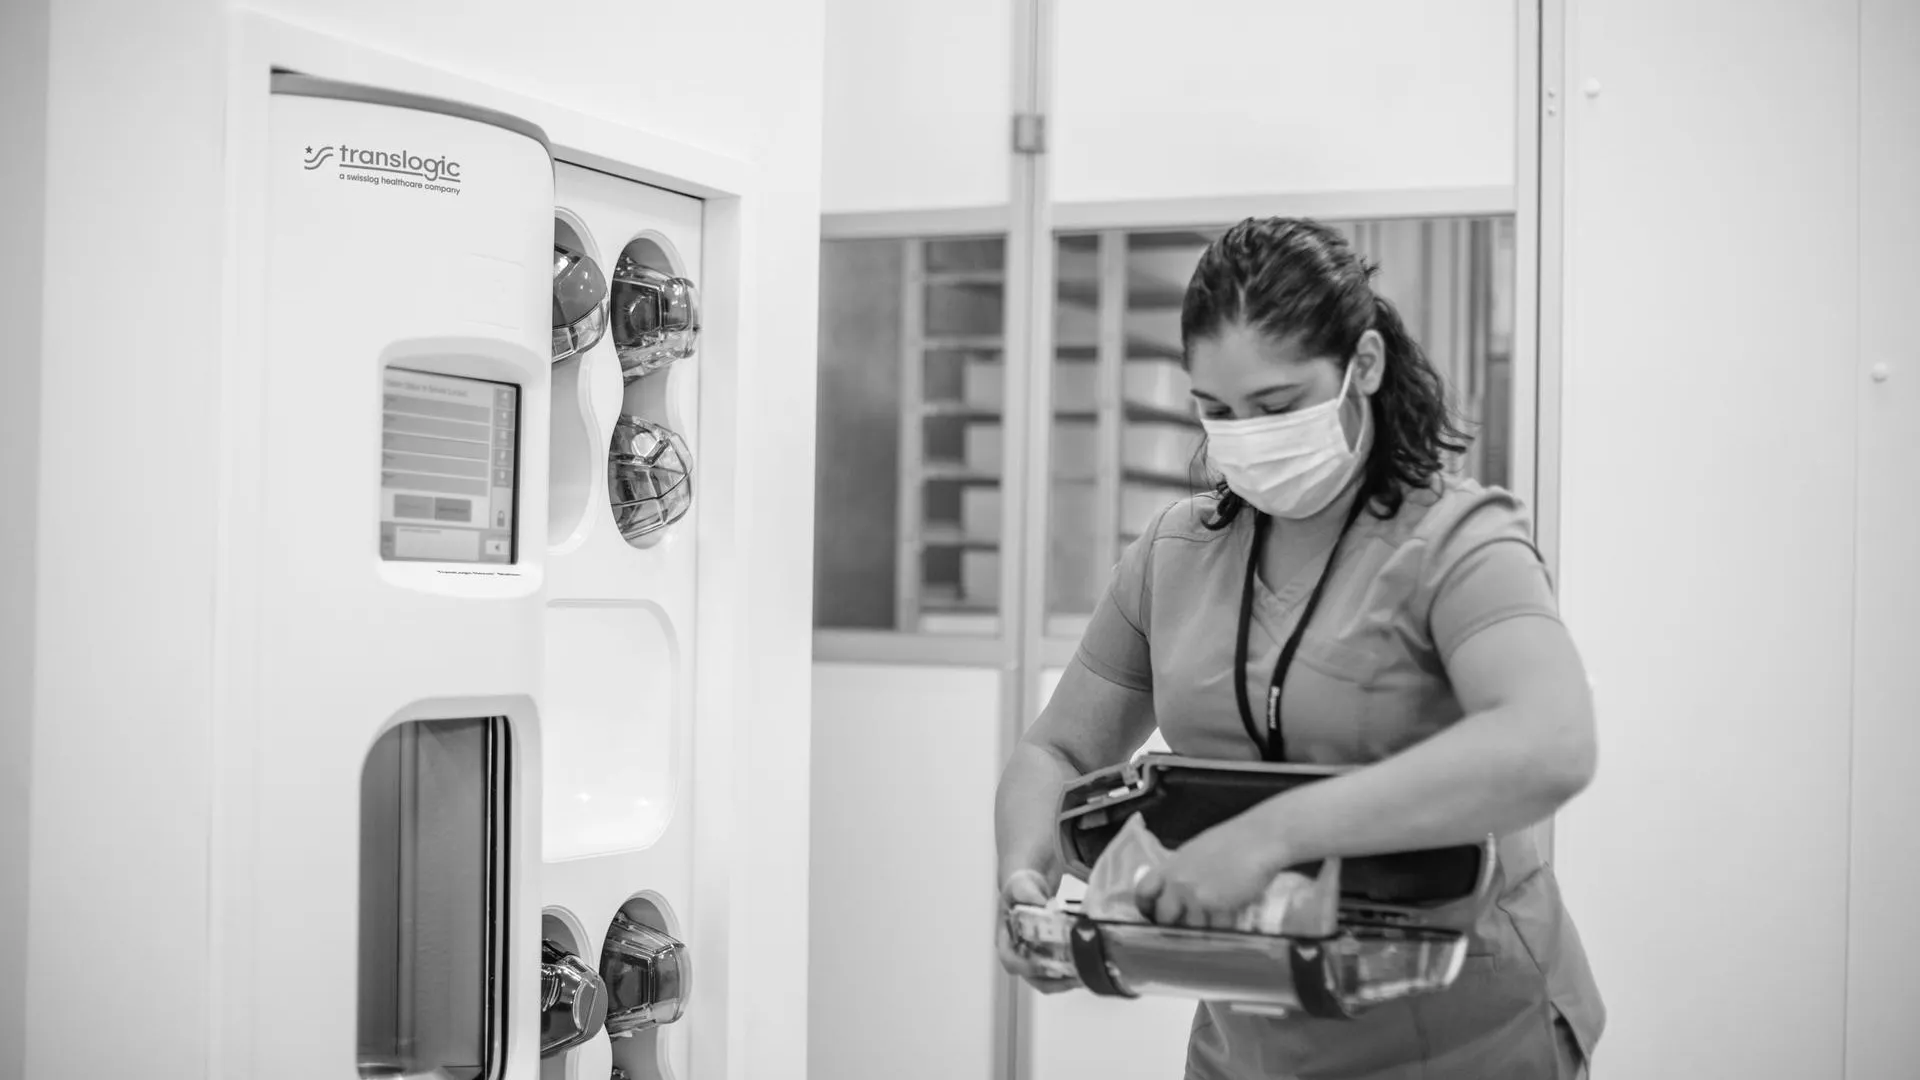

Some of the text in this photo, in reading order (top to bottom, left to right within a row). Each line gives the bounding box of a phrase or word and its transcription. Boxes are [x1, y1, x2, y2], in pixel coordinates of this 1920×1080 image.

[339, 144, 461, 182] translogic
[347, 173, 379, 186] swisslog
[381, 176, 423, 189] healthcare
[424, 183, 461, 196] company
